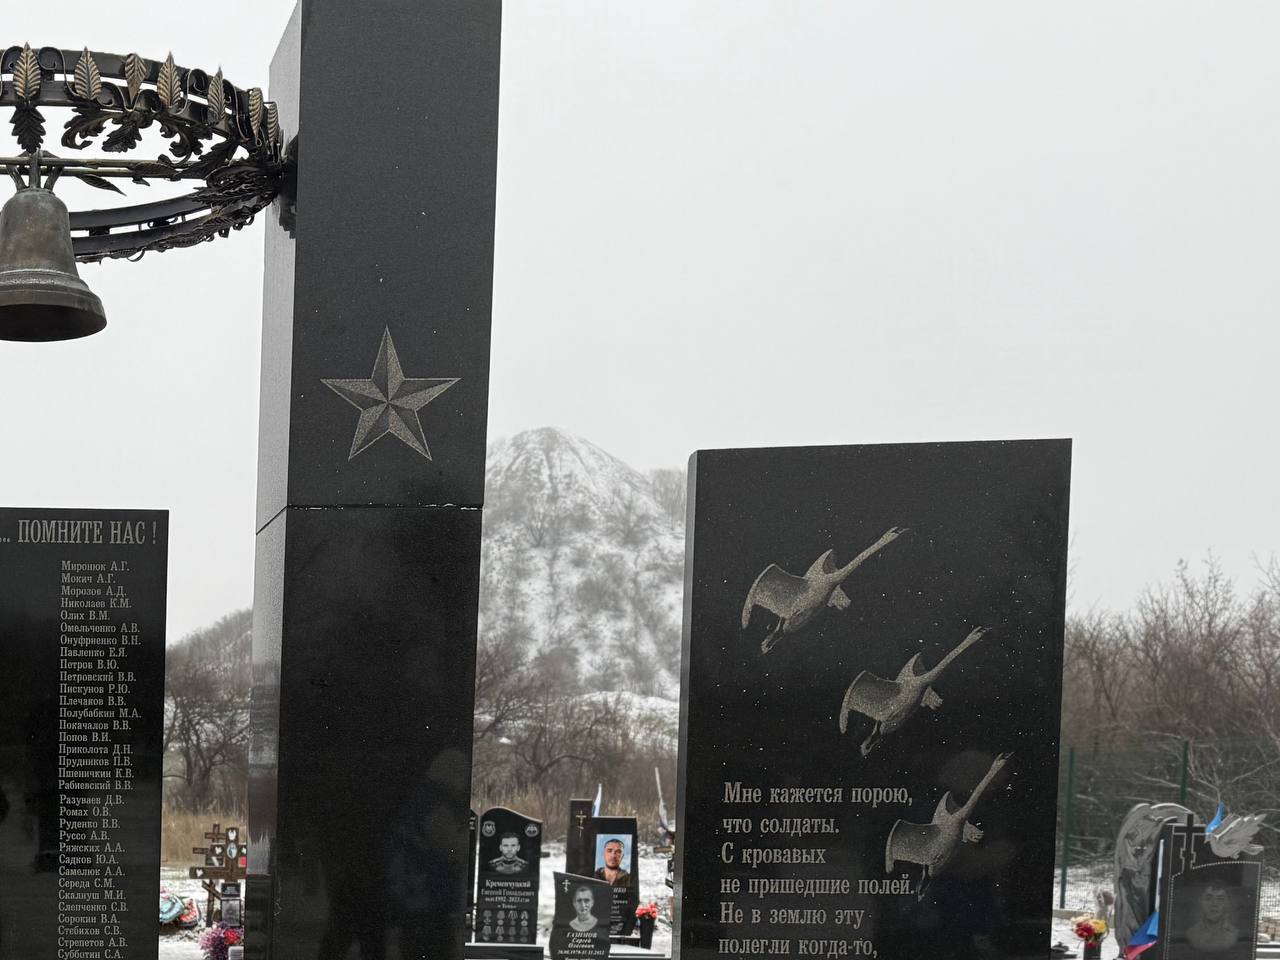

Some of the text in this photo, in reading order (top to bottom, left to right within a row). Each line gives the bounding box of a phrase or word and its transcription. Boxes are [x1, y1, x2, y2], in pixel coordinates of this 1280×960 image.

[17, 520, 103, 544] ПОМНИТЕ
[109, 521, 146, 545] НАС
[61, 585, 102, 598] Морозов
[61, 598, 106, 608] Николаев
[60, 647, 105, 657] Павленко
[60, 659, 93, 672] Петров
[60, 671, 114, 684] Петровский
[60, 683, 105, 696] Пискунов
[59, 732, 88, 742] Попов
[58, 756, 110, 768] Прудников
[58, 768, 112, 778] Пшеничкин
[723, 781, 913, 807] Мне кажется порою,
[59, 818, 98, 830] Руденко
[722, 818, 840, 837] что солдаты.
[58, 854, 92, 866] Садков
[721, 841, 826, 868] С кровавых
[58, 878, 91, 890] Середа
[720, 873, 915, 898] не пришедшие полей.
[58, 913, 97, 926] Сорокин
[719, 902, 865, 929] Не в землю эту
[57, 948, 101, 960] Субботин
[718, 938, 878, 959] полегли когда-то,
